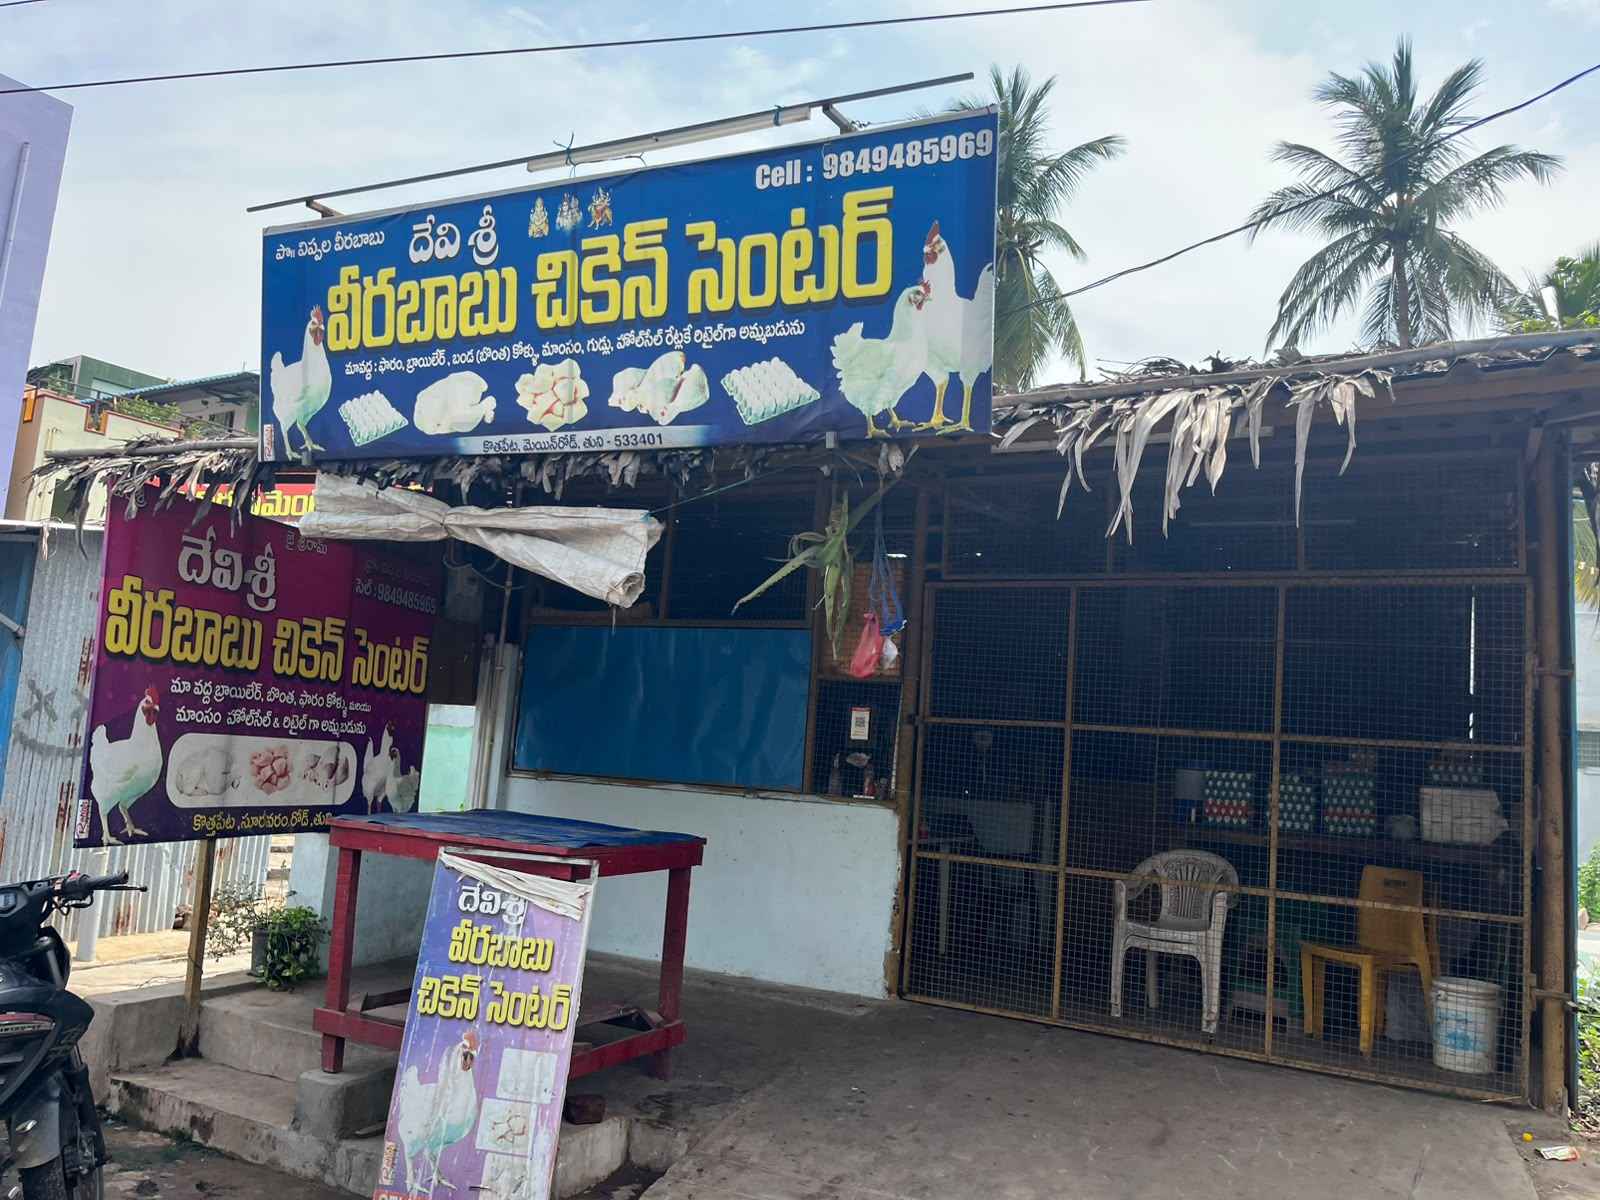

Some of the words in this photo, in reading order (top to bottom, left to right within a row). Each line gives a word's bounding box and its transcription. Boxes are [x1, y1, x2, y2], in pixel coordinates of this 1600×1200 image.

[756, 161, 802, 190] Cell
[822, 129, 994, 181] 9849485969
[334, 230, 386, 252] వీరబాబు
[408, 213, 462, 264] దేవి
[467, 204, 499, 266] శ్రీ
[327, 264, 519, 352] వీరబాబు
[531, 217, 669, 331] చికెన్
[685, 186, 895, 314] సెంటర్
[614, 433, 663, 448] 533401
[105, 575, 263, 672] వీరబాబు
[272, 615, 346, 683] చికెన్
[352, 627, 430, 695] సెంటర్
[448, 918, 555, 973] వీరబాబు
[416, 975, 482, 1021] చికెన్
[486, 980, 574, 1032] సెంటర్
